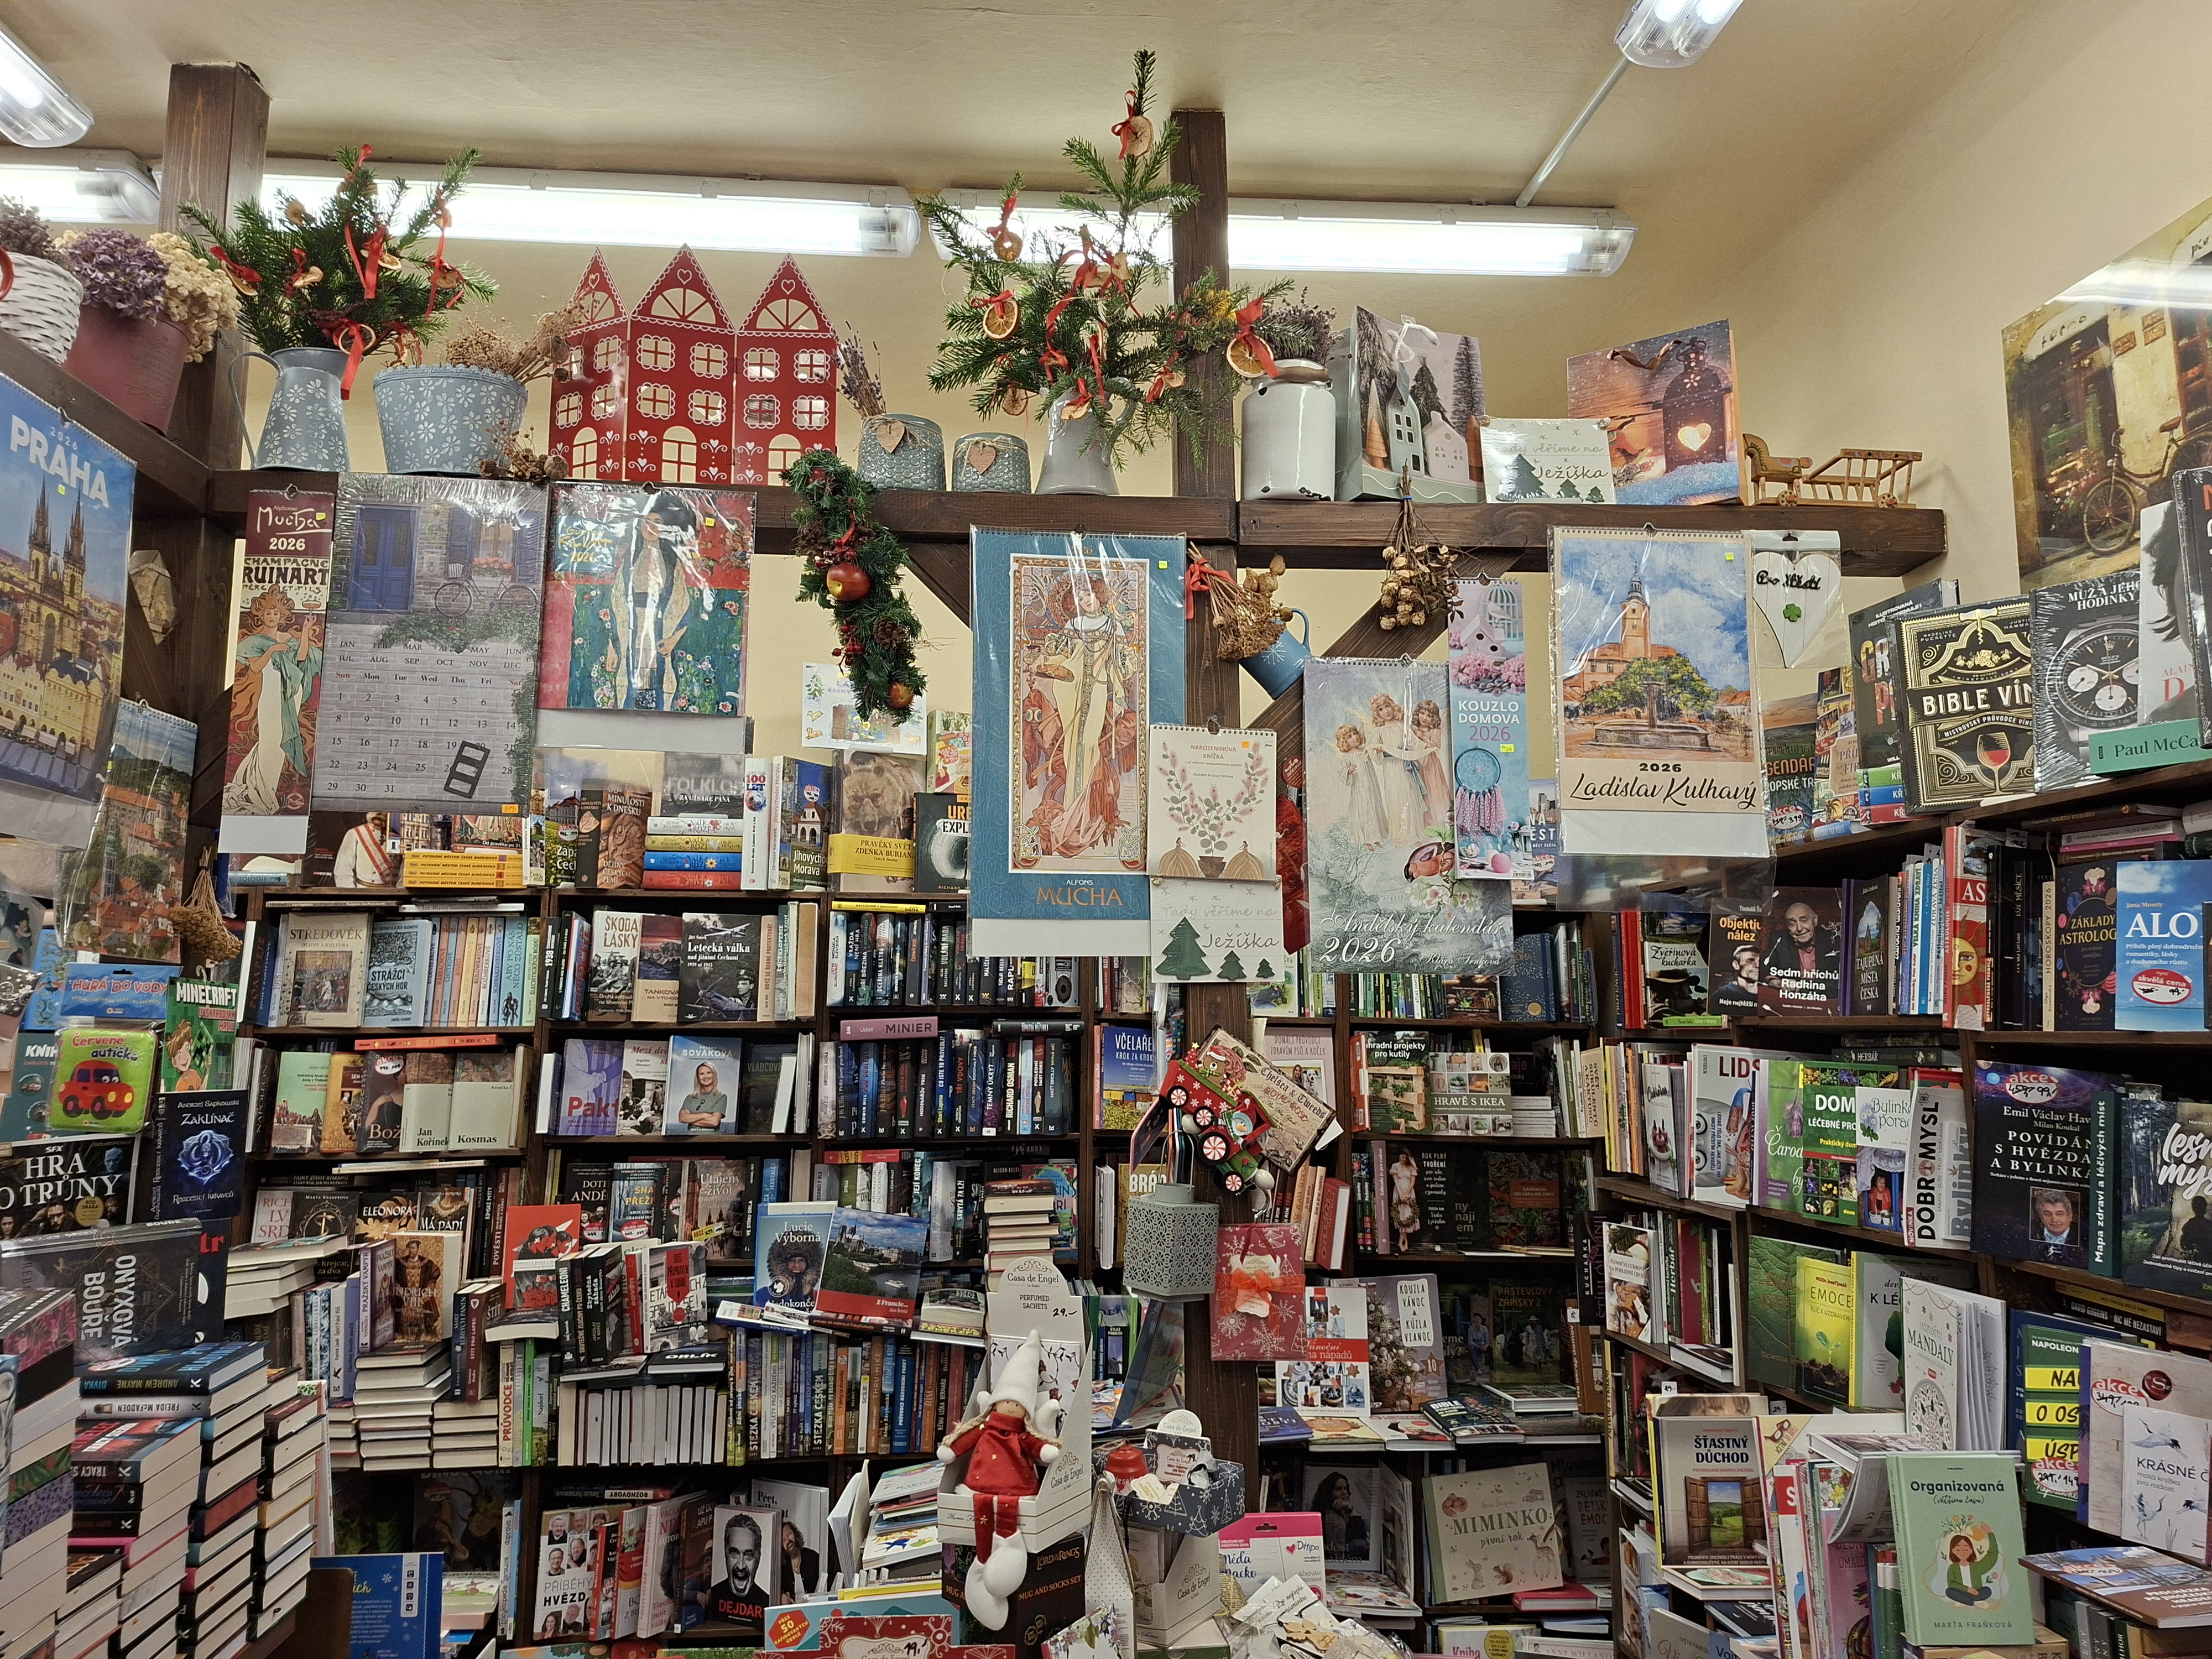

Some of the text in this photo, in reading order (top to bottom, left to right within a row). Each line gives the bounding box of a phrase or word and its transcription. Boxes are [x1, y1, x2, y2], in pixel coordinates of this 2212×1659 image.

[50, 426, 78, 451] 2026
[10, 415, 109, 508] PRAHA
[269, 538, 305, 551] 2026
[243, 557, 330, 567] CHAMPAGNE
[242, 566, 328, 586] RUINART
[2077, 594, 2136, 610] HODINKY
[1920, 633, 1957, 642] PUCKETTE
[1458, 700, 1520, 712] KOUZLO
[1923, 688, 1990, 716] BIBLE
[1458, 712, 1520, 725] DOMOVA
[1944, 714, 2017, 737] MISTROVSKÝ PRŮVODCE
[1469, 725, 1510, 742] 2026
[1191, 744, 1237, 754] NAROZENINOVÁ
[1202, 752, 1224, 760] KNÍŽKA
[2114, 741, 2150, 759] Paul
[1639, 763, 1682, 773] 2026
[1569, 773, 1757, 810] Ladislav Kulhavý
[607, 794, 645, 808] MINULOSTI
[613, 803, 641, 816] DNEŠKU
[854, 846, 883, 856] ZDEŇKA
[860, 838, 911, 850] PRAVĚKÝ SVĚT
[793, 863, 820, 876] Morava
[1036, 886, 1123, 906] MUCHA
[1162, 904, 1277, 920] Tady věříme na
[604, 915, 639, 933] ŠKODA
[1319, 911, 1506, 945] Andělský kalendář
[2071, 915, 2115, 929] ZÁKLADY
[290, 926, 363, 942] STŘEDOVĚK
[603, 931, 638, 948] LÁSKY
[1202, 932, 1280, 950] Ježíška
[1726, 930, 1756, 941] nález
[687, 942, 750, 953] Letecká válka
[1319, 936, 1401, 963] 2026
[1650, 946, 1697, 960] Zvěřinová
[699, 953, 716, 962] jižními
[1662, 956, 1697, 968] kuchařka
[1856, 952, 1884, 971] TAJUPLNÁ
[371, 969, 405, 982] STRÁŽCI
[1770, 967, 1839, 981] Sedm hříchů
[1860, 971, 1879, 985] MÍSTA
[72, 979, 168, 994] HURÁ DO VODY
[1781, 978, 1825, 990] Radkina
[2137, 975, 2187, 988] skvělá cena
[176, 982, 237, 1008] MINECRAFT
[1779, 989, 1827, 1002] Honzáka
[1860, 985, 1879, 1000] ČESKA
[885, 1022, 932, 1034] MINIER
[72, 1032, 125, 1046] Červené
[682, 1048, 733, 1058] SOVÁKOVÁ
[1394, 1042, 1426, 1052] projekty
[91, 1047, 138, 1062] autíčko
[1389, 1049, 1410, 1060] kutily
[1259, 1066, 1327, 1120] Chelsea & Tweeds
[1434, 1096, 1505, 1107] HRAVĚ S IKEA
[2003, 1106, 2066, 1122] Emil Václav
[1808, 1117, 1842, 1130] LÉČEBNÉ
[417, 1128, 432, 1137] Jan
[457, 1135, 497, 1144] Kosmas
[45, 1145, 64, 1153] SFX
[24, 1152, 87, 1180] HRA
[2095, 1100, 2107, 1263] Mapa zdraví a léčivých míst
[19, 1173, 123, 1209] TRŮNY
[706, 1185, 733, 1197] život
[363, 1206, 413, 1217] ELEONORA
[783, 1221, 813, 1232] Lucie
[775, 1232, 821, 1244] Výborná
[1007, 1272, 1059, 1284] Casa de Engel
[559, 1266, 570, 1312] CHAMELEONI
[1399, 1283, 1426, 1295] KOUZLA
[111, 1254, 137, 1349] ONYXOVÁ
[1402, 1295, 1426, 1308] VÁNOC
[1810, 1286, 1851, 1308] EMOCE
[80, 1271, 106, 1342] BOUŘE
[1405, 1317, 1427, 1329] KÚZLA
[1404, 1331, 1432, 1344] VIANOC
[1907, 1327, 1955, 1366] MANDALY
[2031, 1339, 2079, 1354] NAPOLEON
[665, 1352, 718, 1360] ORLÍK
[873, 1352, 881, 1399] THRU-HIKE
[117, 1379, 179, 1389] ANDREW MAYNE
[2095, 1379, 2138, 1396] akce
[117, 1404, 153, 1412] McFADDEN
[814, 1374, 823, 1445] STEZKA ČESKEM
[1694, 1436, 1748, 1449] ŠŤASTNÝ
[1695, 1448, 1749, 1464] DŮCHOD
[2137, 1457, 2196, 1479] KRÁSNÉ
[2137, 1472, 2180, 1486] malá knížka
[1910, 1481, 2005, 1493] Organizovaná
[2151, 1483, 2175, 1492] radost
[1453, 1508, 1548, 1536] MIMINKO
[1480, 1531, 1524, 1548] první rok
[544, 1577, 593, 1593] PŘÍBĚHY
[1019, 1575, 1081, 1600] MUG AND SOCKS SET
[543, 1592, 586, 1607] HVĚZD
[719, 1600, 763, 1619] DEJDAR
